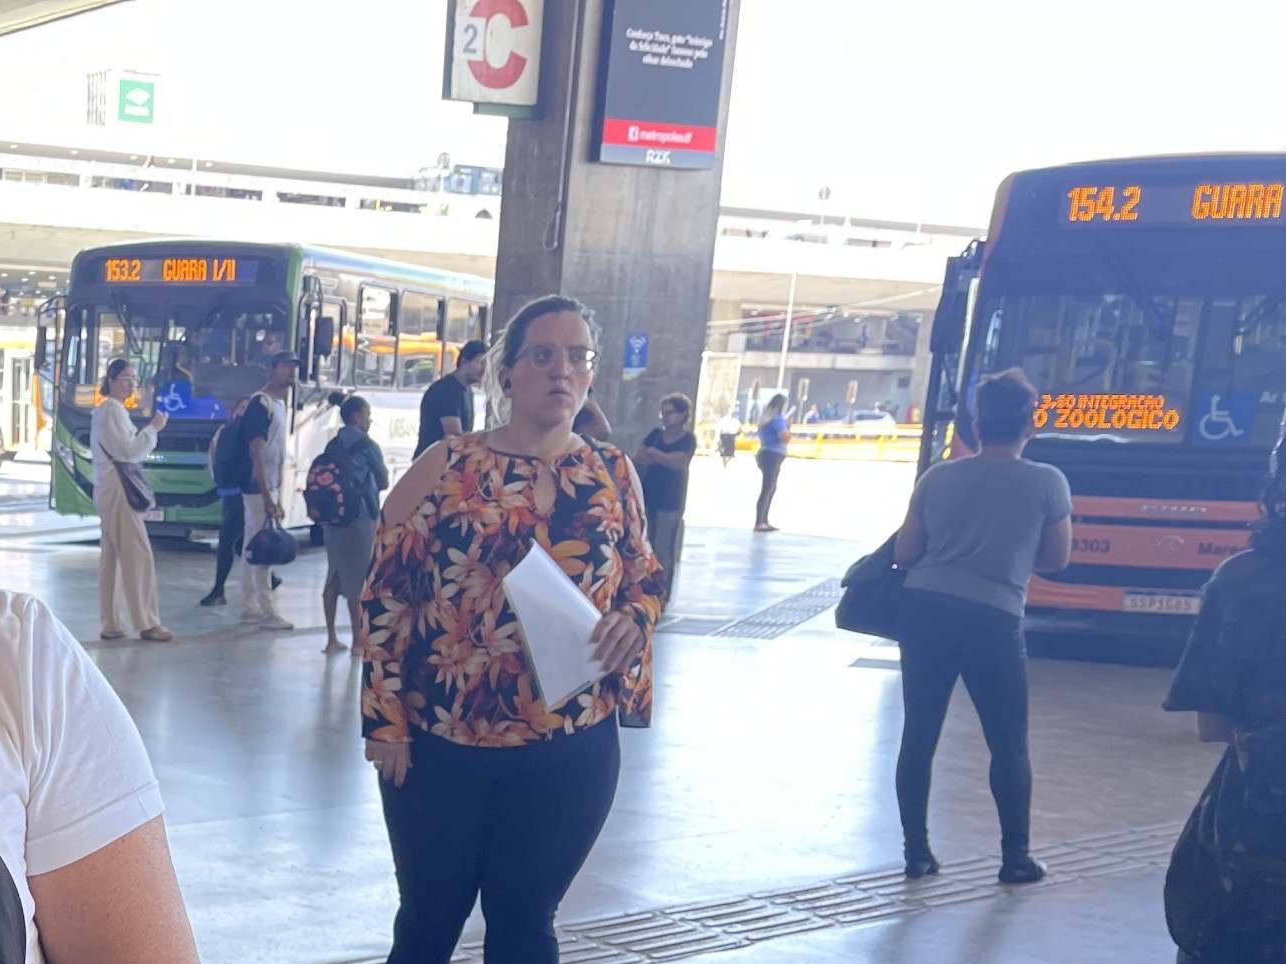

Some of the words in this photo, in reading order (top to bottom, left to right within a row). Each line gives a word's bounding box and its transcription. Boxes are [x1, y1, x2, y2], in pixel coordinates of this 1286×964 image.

[462, 24, 478, 54] 2
[1067, 185, 1141, 222] 154.2
[1191, 183, 1285, 220] GUARA
[105, 258, 143, 282] 153.2
[162, 258, 207, 282] GUARA
[1054, 408, 1180, 430] ZOOLOGICO
